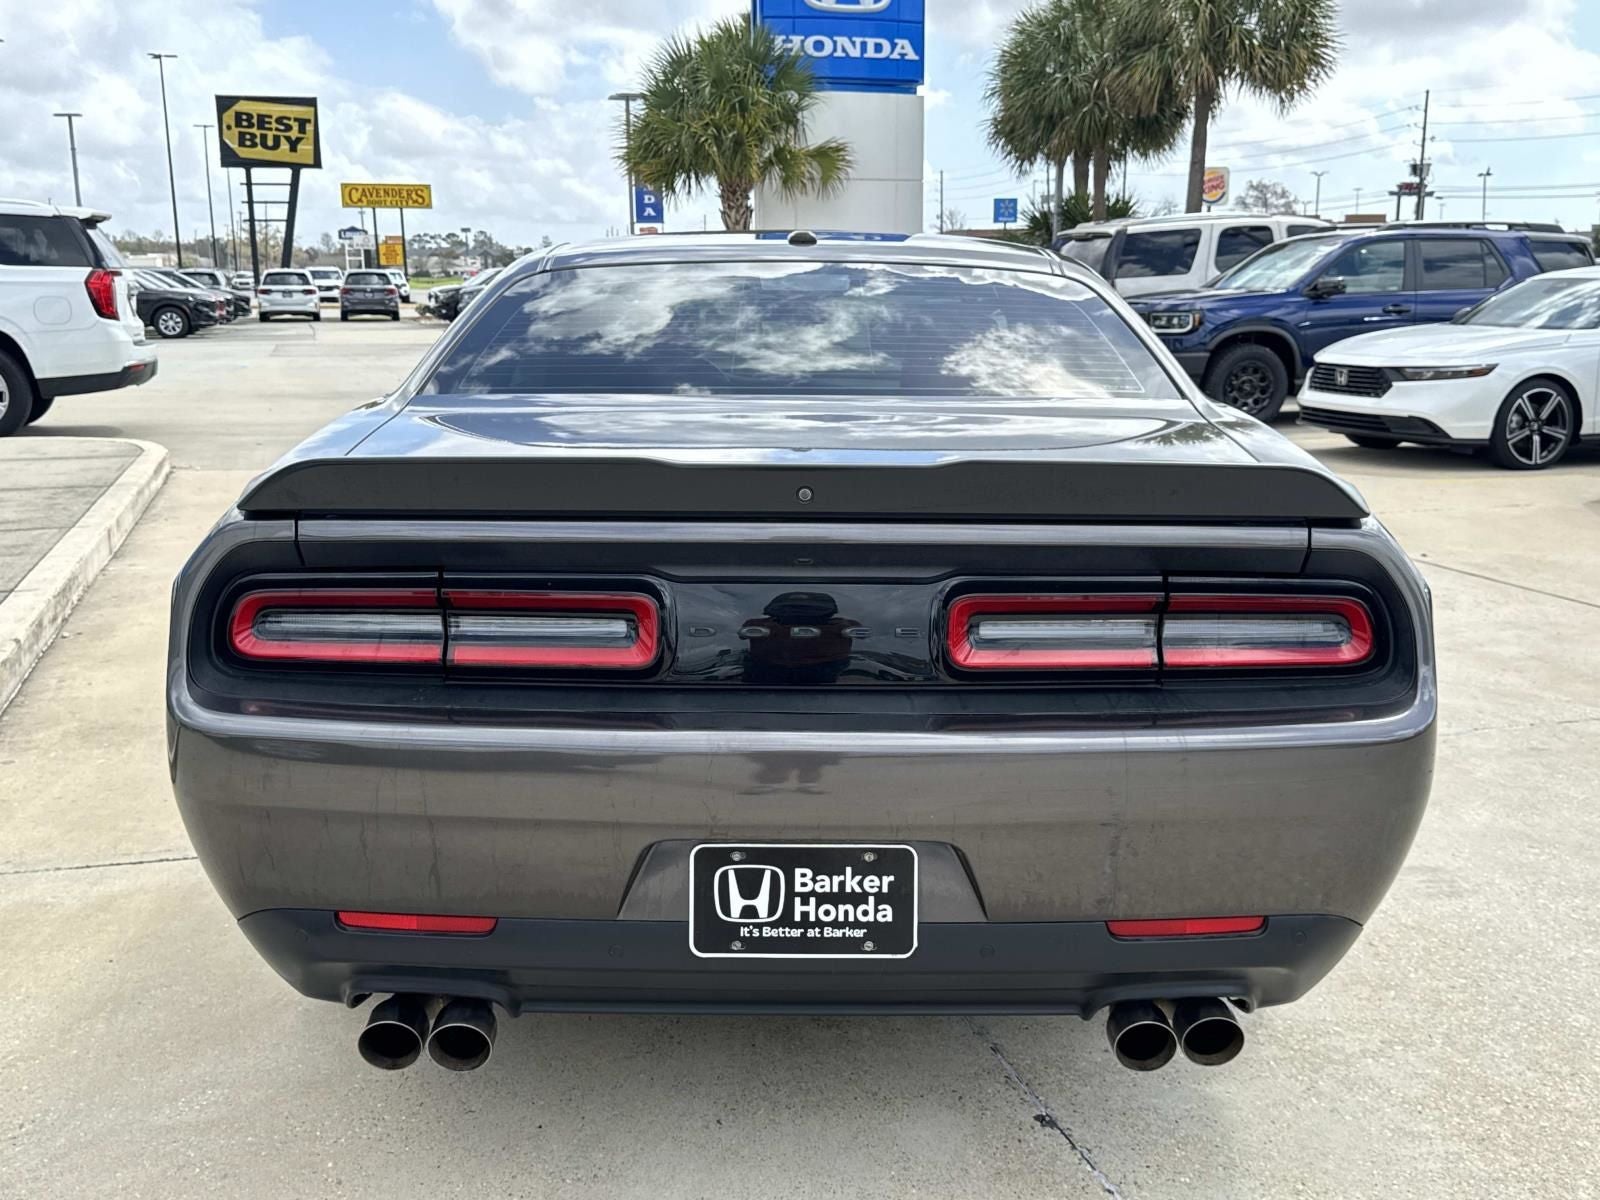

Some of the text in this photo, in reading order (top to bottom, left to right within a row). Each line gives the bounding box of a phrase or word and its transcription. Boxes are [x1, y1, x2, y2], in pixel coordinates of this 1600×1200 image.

[770, 35, 919, 60] HONDA
[234, 111, 311, 135] BEST
[237, 131, 305, 153] BUY
[348, 187, 426, 205] CAVENDER'S
[689, 626, 921, 638] DODGE
[794, 867, 894, 893] Barker
[794, 896, 893, 922] Honda
[740, 925, 867, 938] It's Better at Barker
